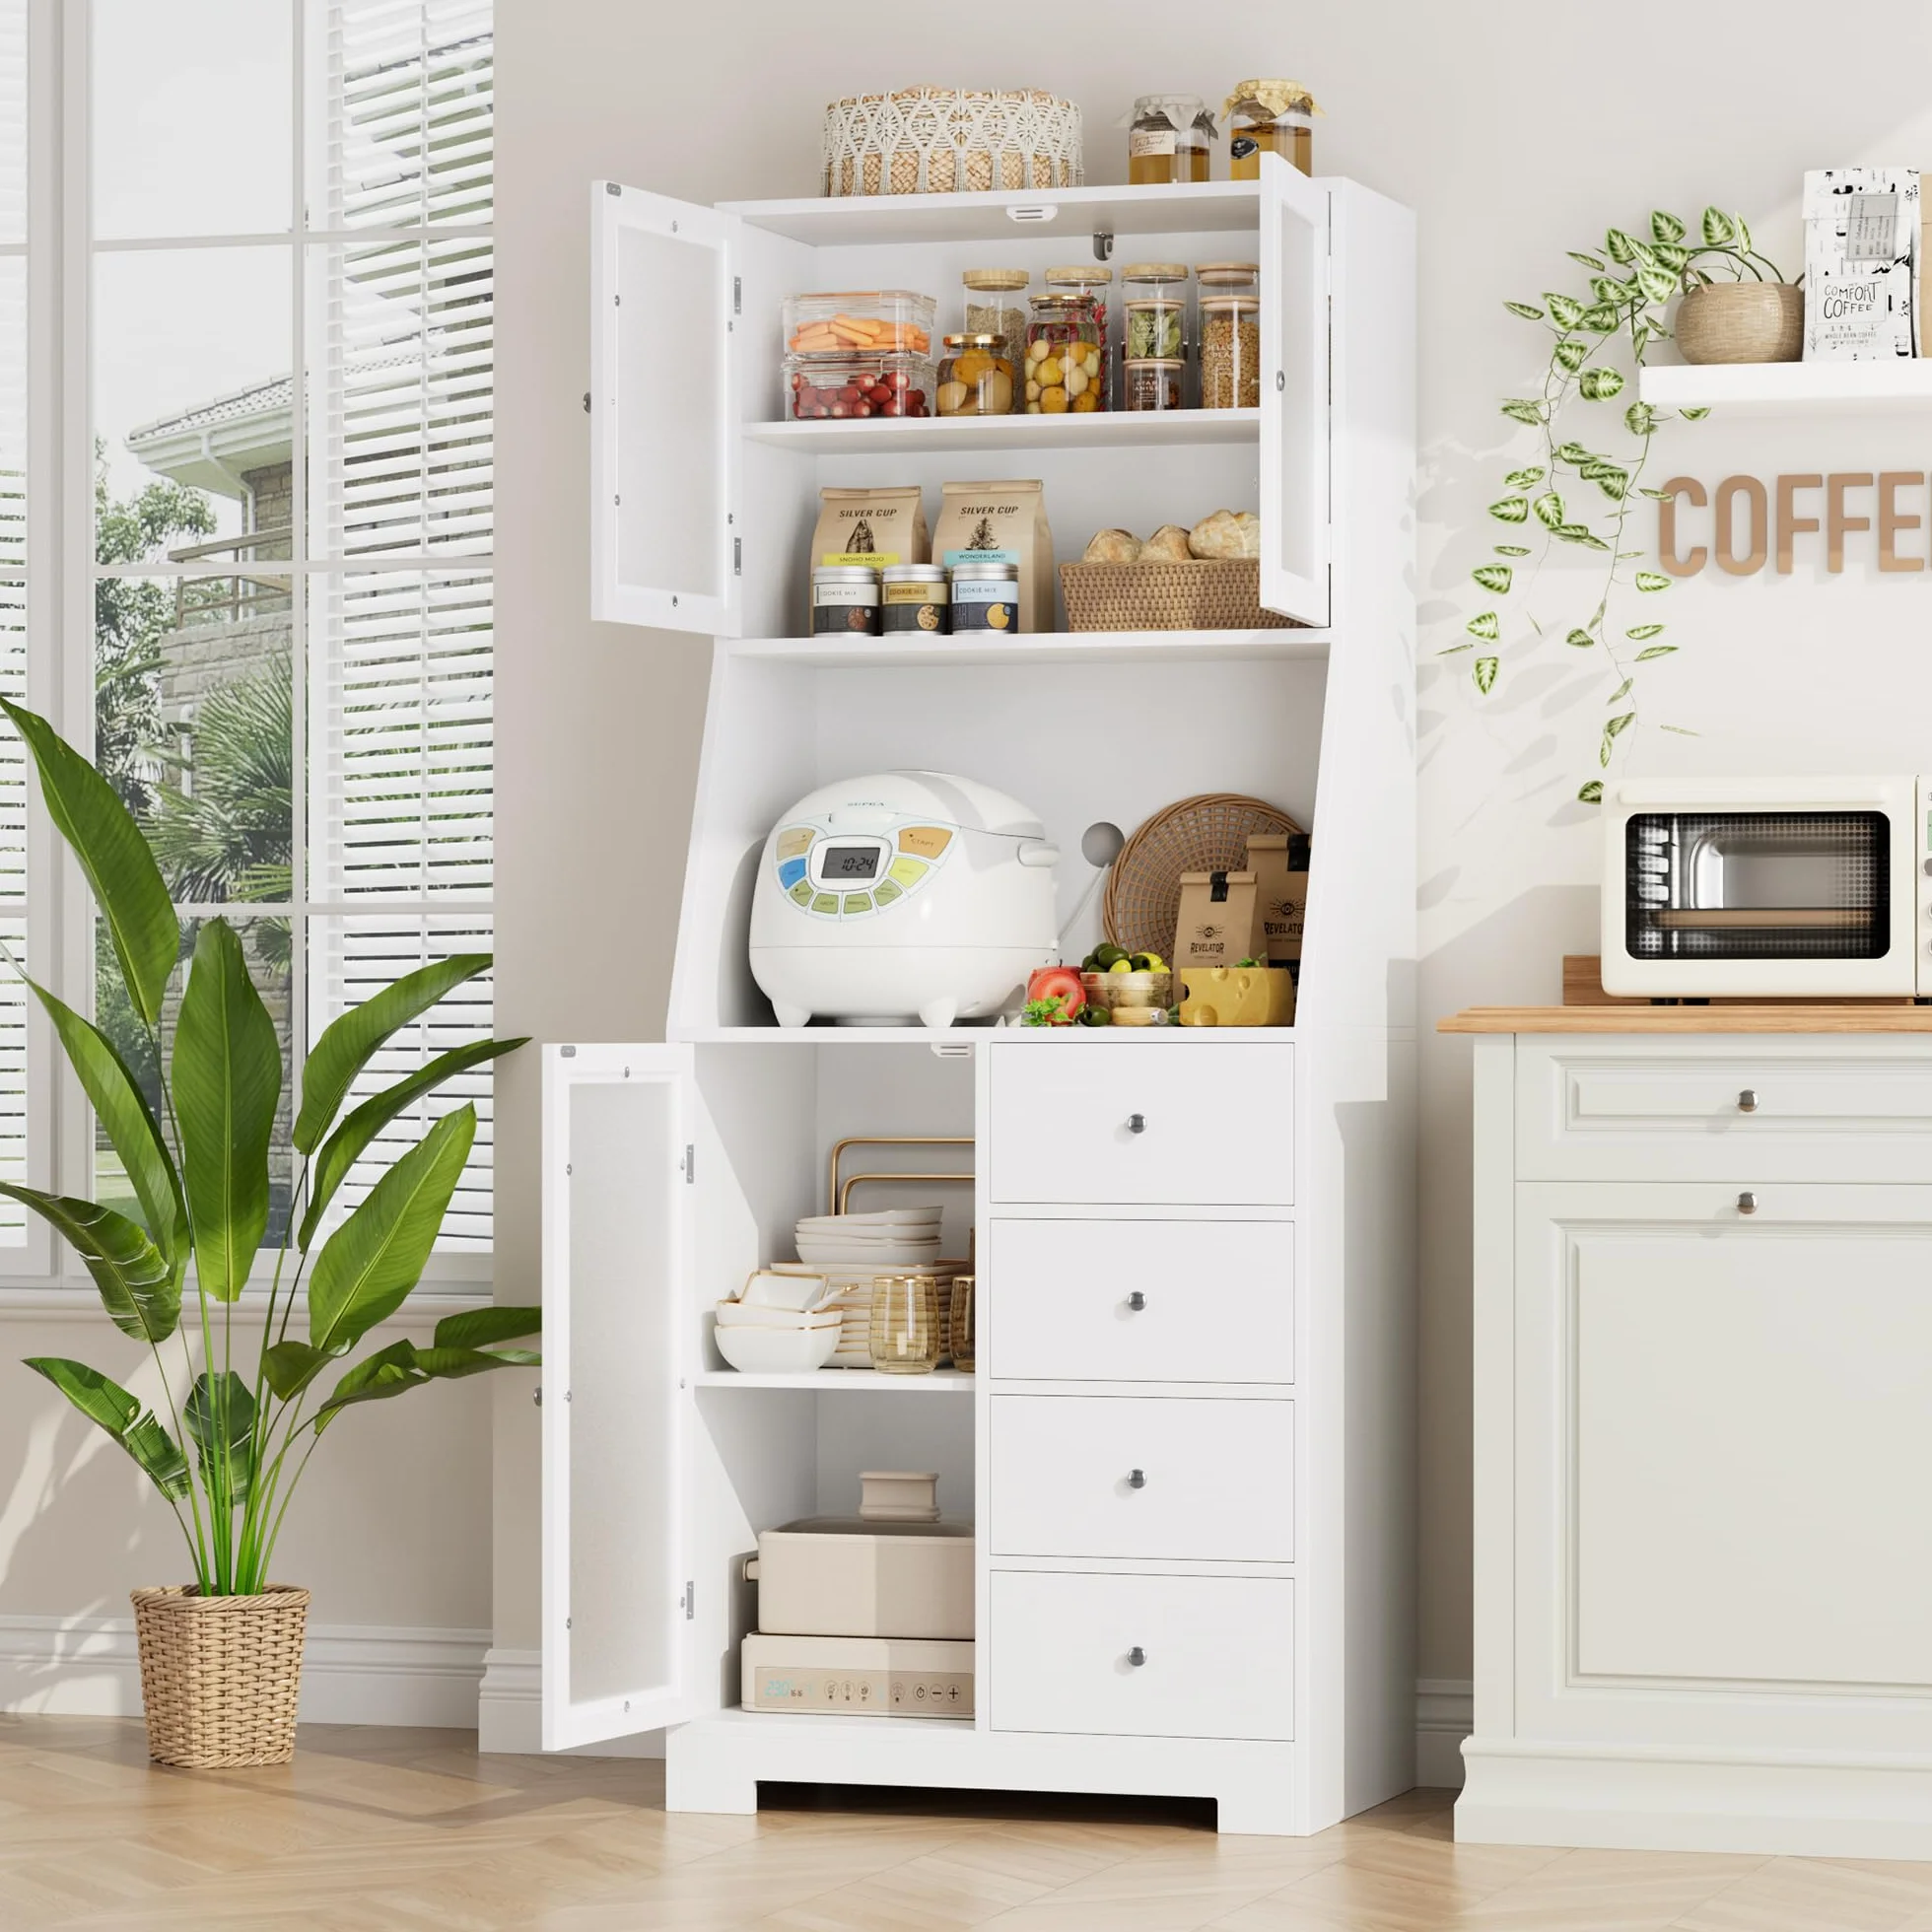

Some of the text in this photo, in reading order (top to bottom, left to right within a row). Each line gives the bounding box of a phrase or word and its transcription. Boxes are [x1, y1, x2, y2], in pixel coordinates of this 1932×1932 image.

[1825, 281, 1882, 303] COMFORT
[1824, 297, 1873, 319] COFFEE
[839, 510, 872, 518] SILVER
[1659, 471, 1932, 578] COFFE
[842, 857, 874, 871] 10:24
[1264, 922, 1303, 935] REVELATO
[1191, 942, 1225, 954] REVELATOR
